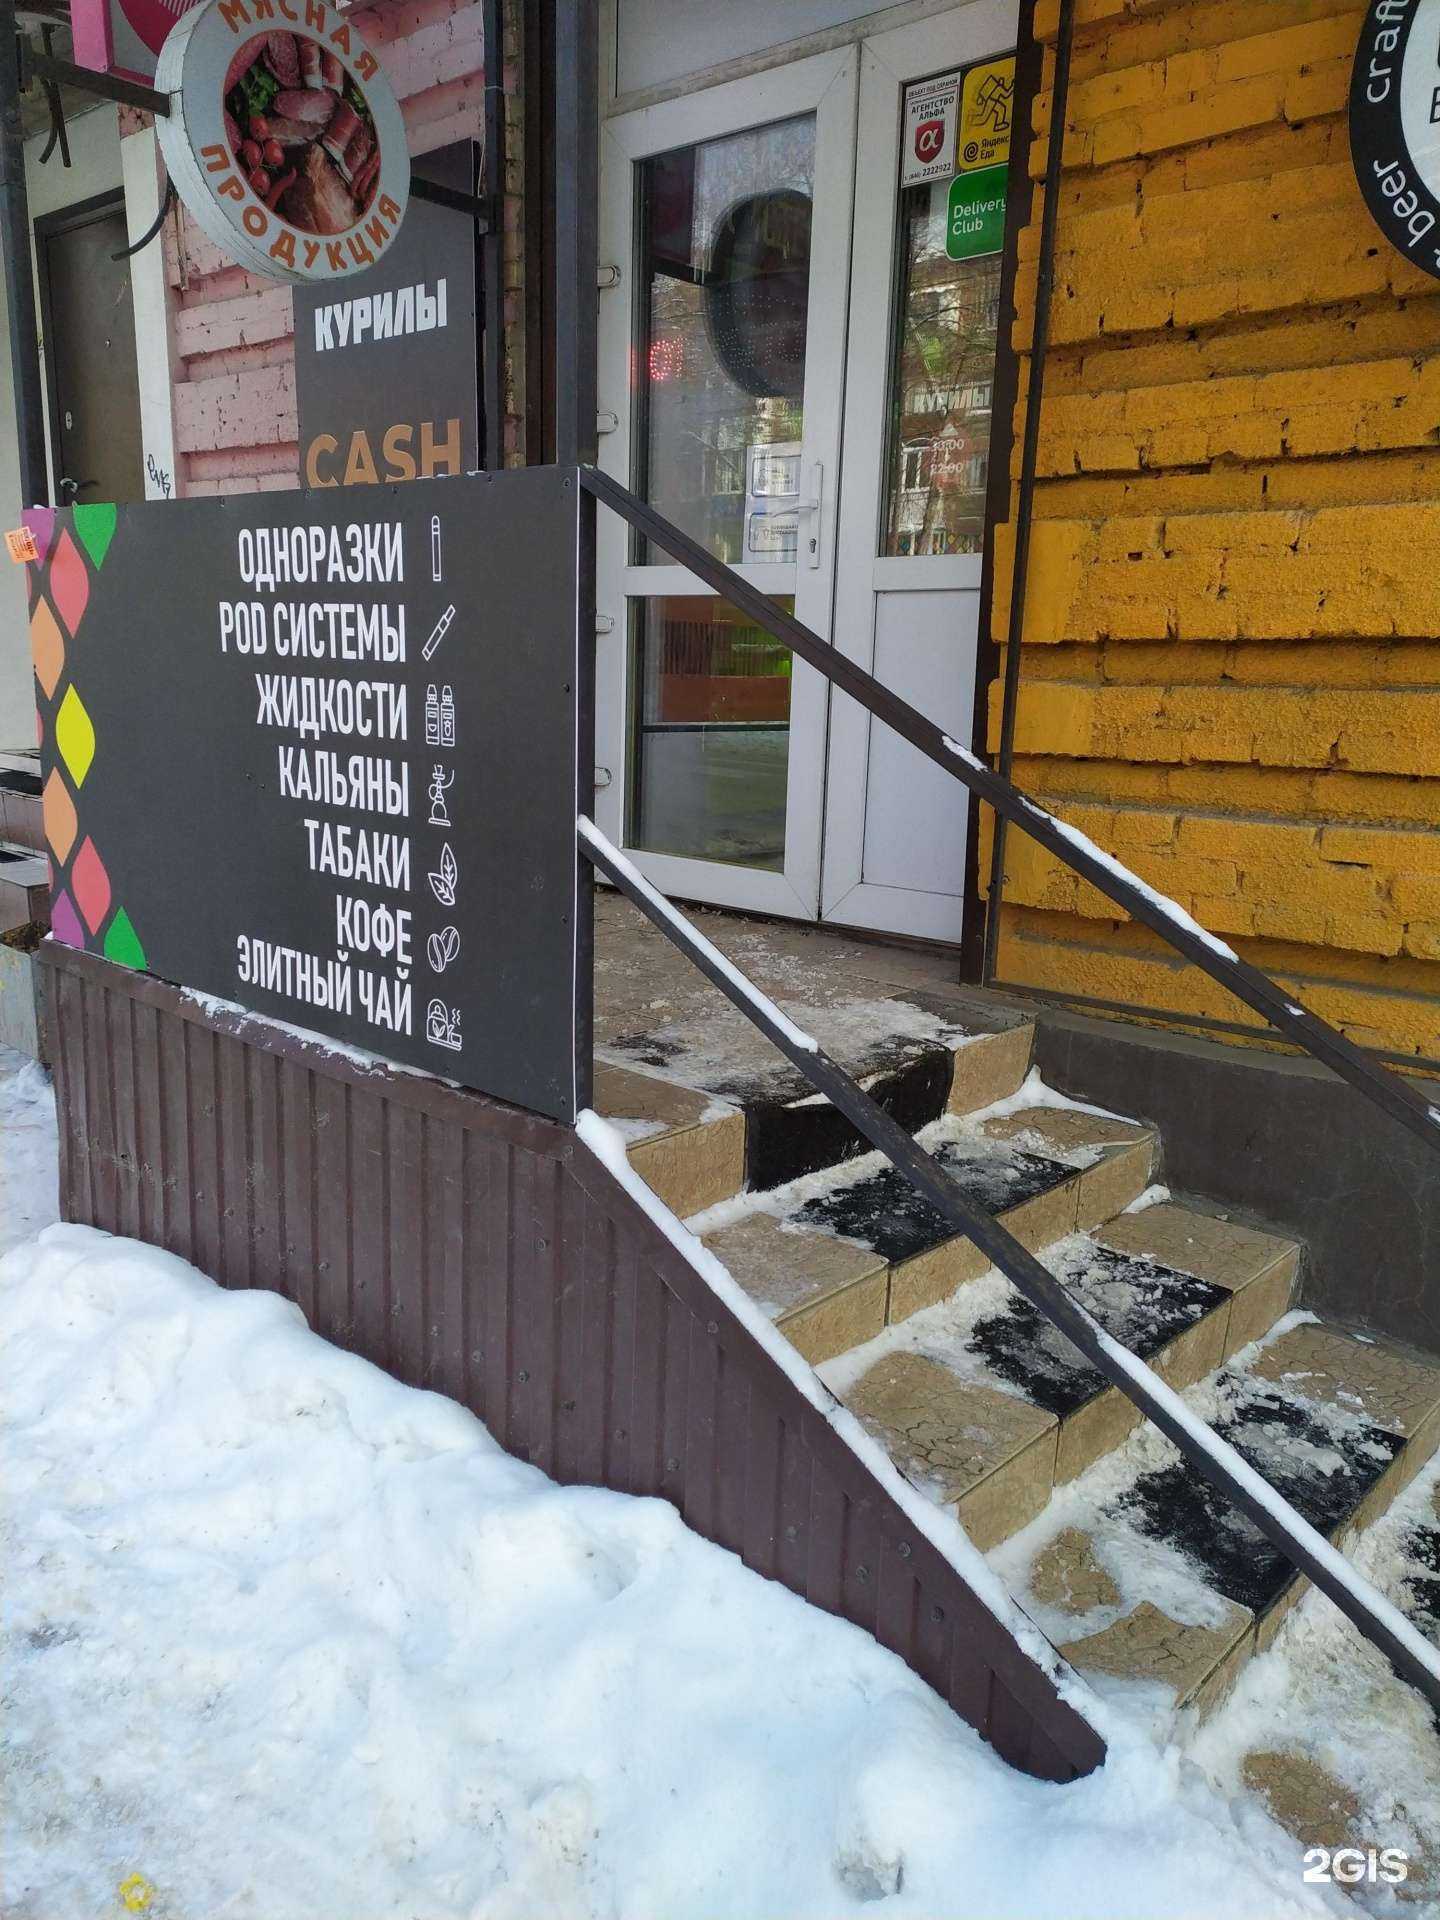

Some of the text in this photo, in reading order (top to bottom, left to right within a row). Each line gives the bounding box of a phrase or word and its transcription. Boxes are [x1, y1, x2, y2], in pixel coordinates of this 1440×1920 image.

[217, 0, 380, 82] МЯСНАЯ
[911, 95, 954, 115] АГЕНТСТВО
[919, 107, 945, 121] АЛЬФА
[201, 143, 402, 272] ПРОДУКЦИЯ
[952, 218, 984, 236] Club
[953, 197, 1007, 219] Delivery
[1373, 159, 1436, 248] beer
[314, 278, 447, 352] КУРИЛЫ
[306, 418, 461, 489] CASH
[238, 522, 405, 593] ОДНОРАЗКИ
[219, 601, 406, 663] POD СИСТЕМЫ
[255, 673, 408, 741] ЖИДКОСТИ
[278, 745, 409, 817] КАЛЬЯНЫ
[304, 818, 411, 892] ТАБАКИ
[336, 893, 412, 965] КОФЕ
[237, 934, 412, 1036] ЭЛИТНЫЙ ЧАЙ
